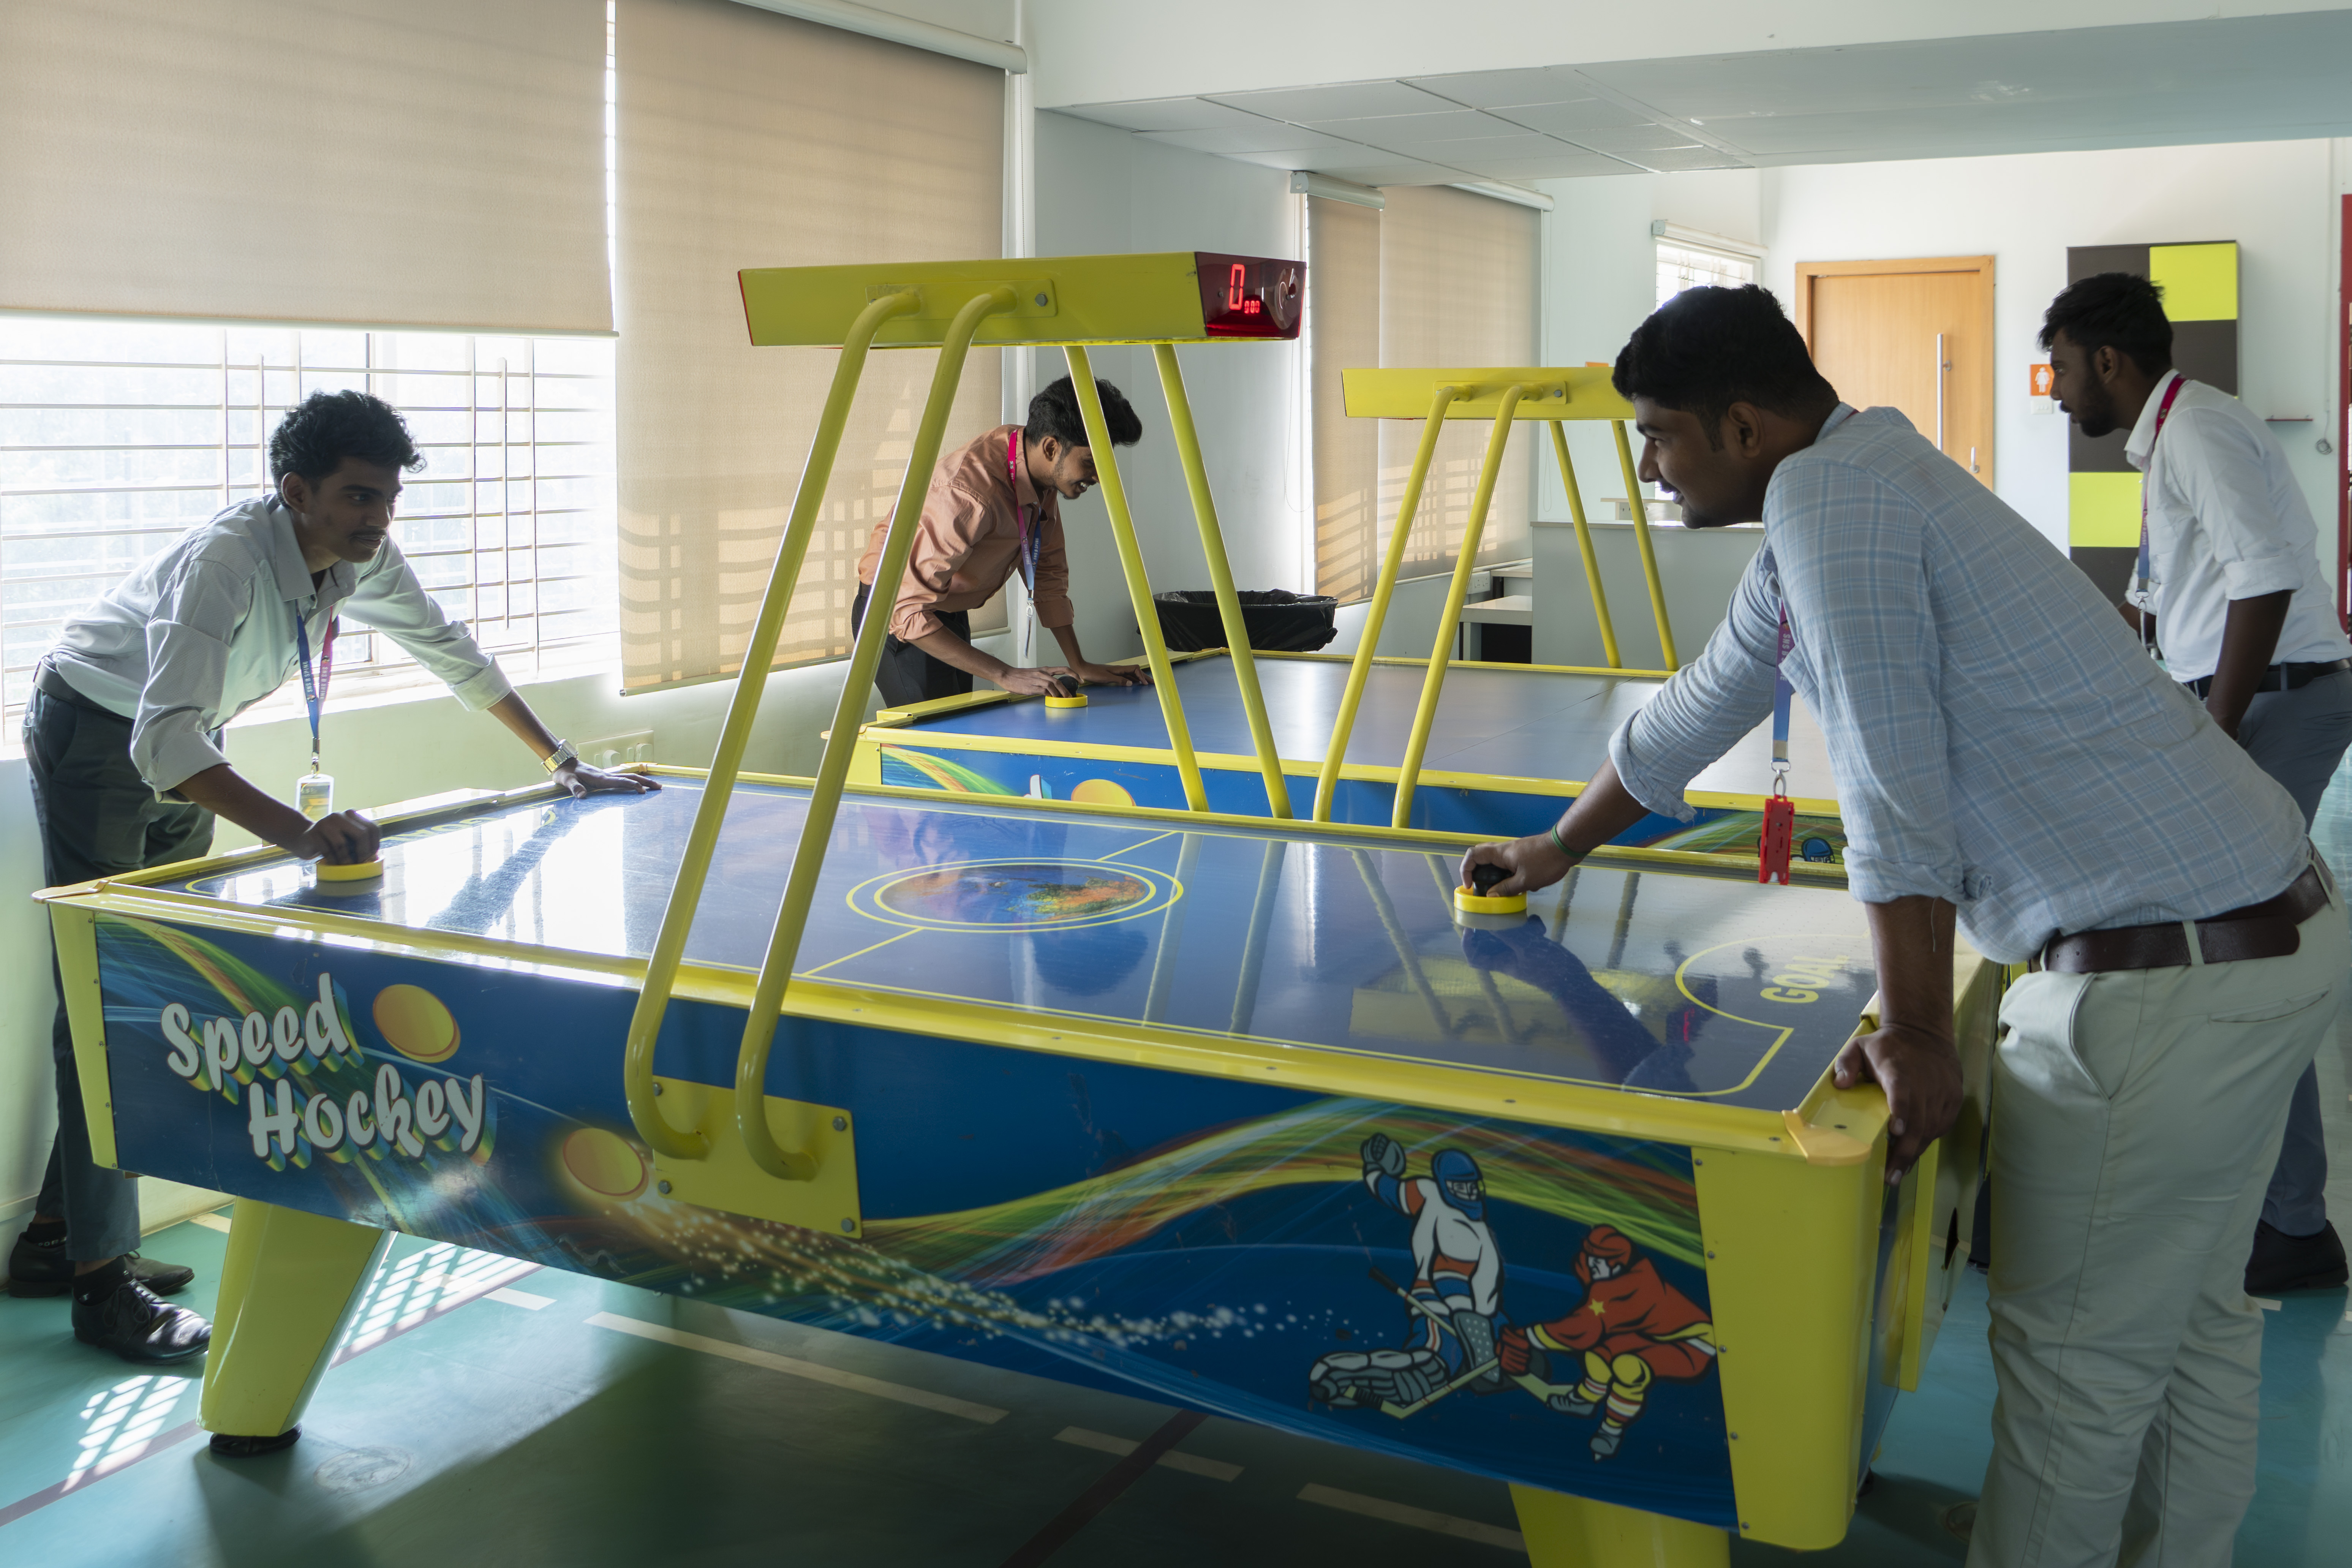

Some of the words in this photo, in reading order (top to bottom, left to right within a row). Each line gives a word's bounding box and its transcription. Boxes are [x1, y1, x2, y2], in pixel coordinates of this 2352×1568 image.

[1229, 264, 1245, 310] 0
[1782, 633, 1791, 650] SNS
[1759, 955, 1849, 1004] GOAL
[160, 972, 351, 1092] Speed
[248, 1062, 487, 1160] Hockey
